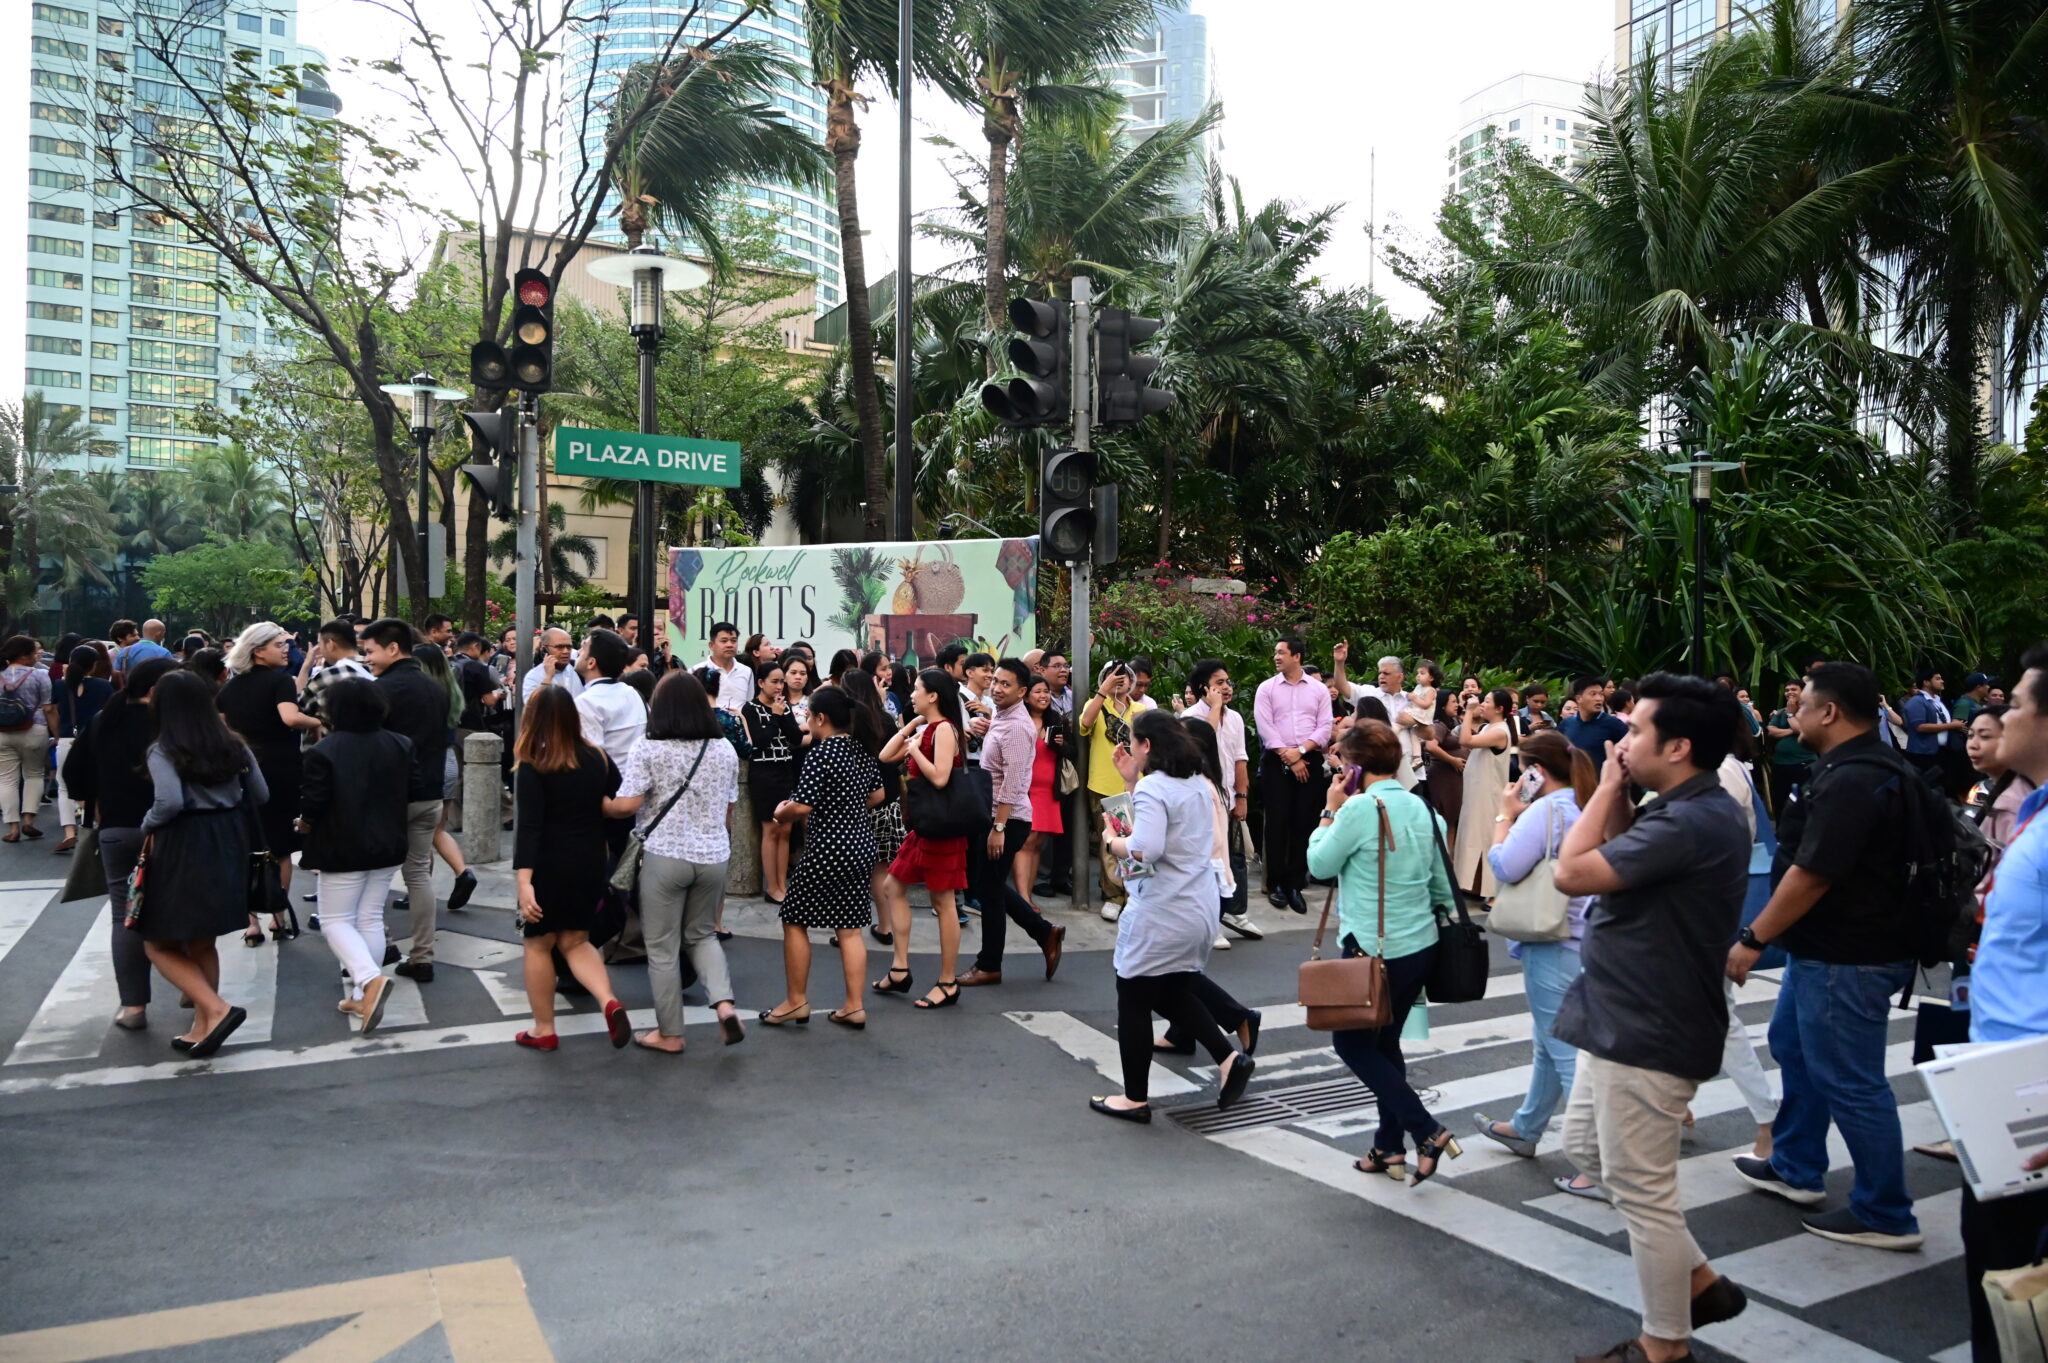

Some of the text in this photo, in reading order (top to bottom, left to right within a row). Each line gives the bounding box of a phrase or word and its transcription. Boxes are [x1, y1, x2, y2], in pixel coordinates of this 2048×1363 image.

[569, 441, 727, 473] PLAZA DRIVE
[715, 549, 807, 595] Rockwell
[699, 585, 816, 640] ROOTS
